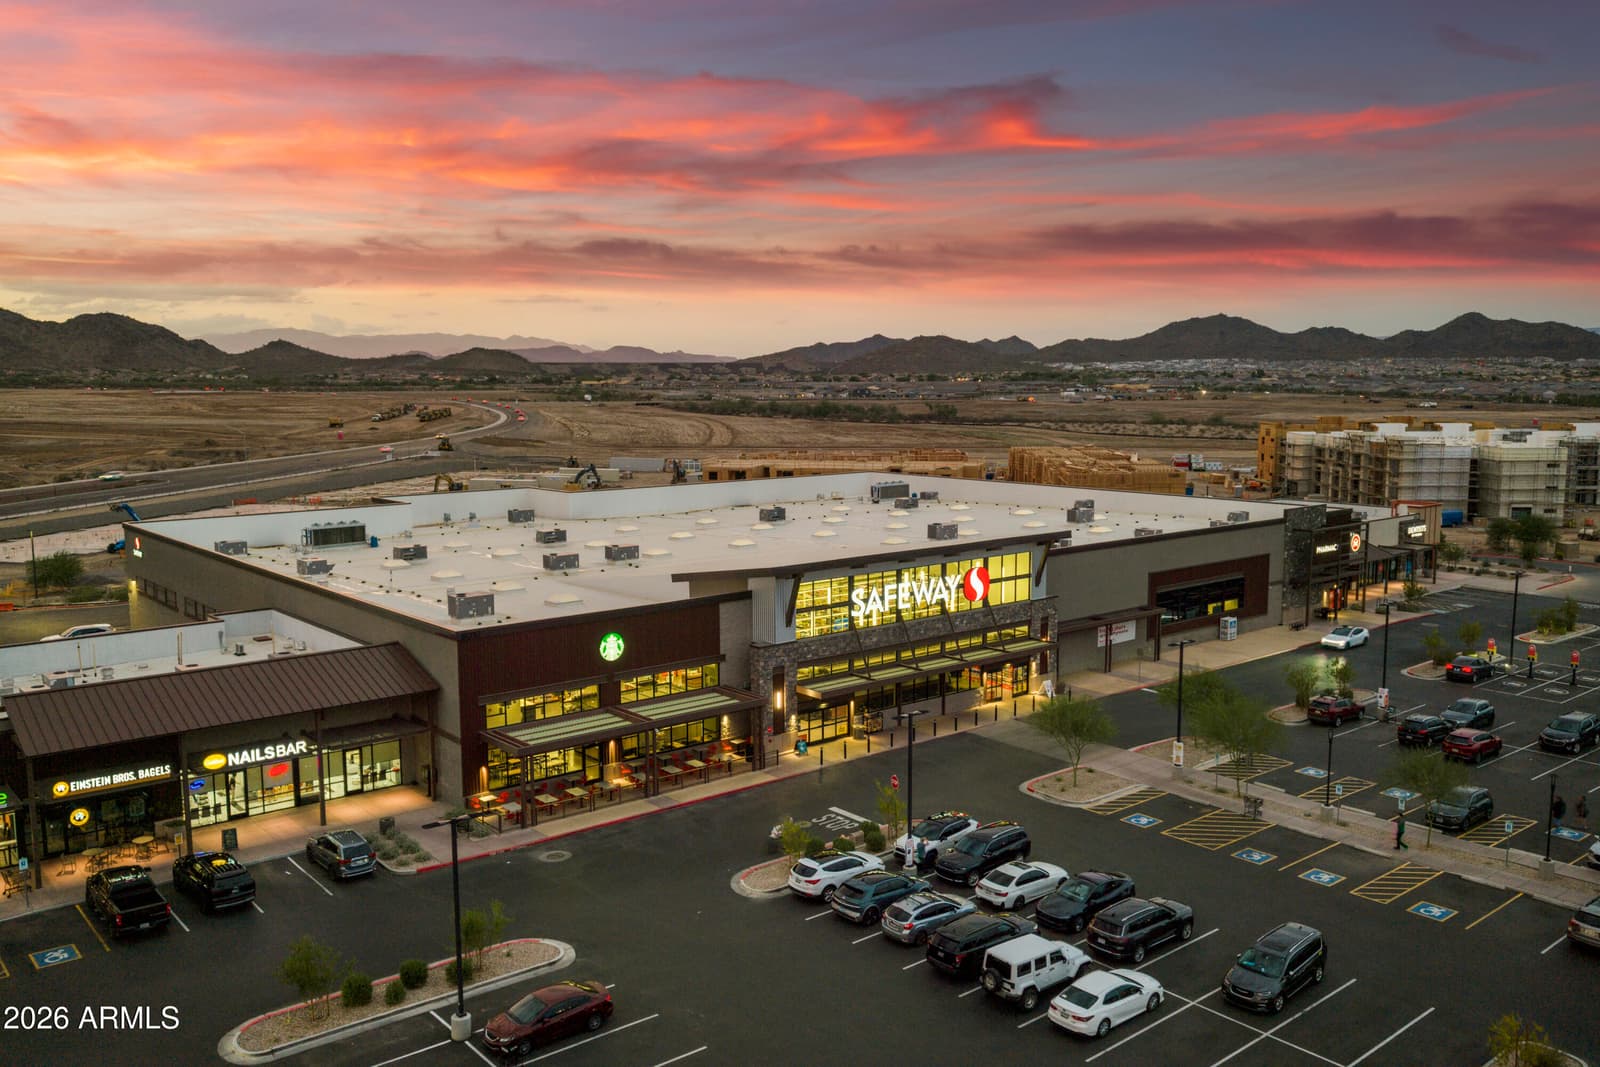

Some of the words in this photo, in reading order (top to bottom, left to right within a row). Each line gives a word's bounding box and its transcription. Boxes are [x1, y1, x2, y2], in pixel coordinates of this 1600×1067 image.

[1316, 543, 1338, 554] PHARMAC
[851, 574, 961, 616] SAFEWAY
[70, 775, 111, 791] EINSTEIN
[112, 771, 136, 784] BROS.
[138, 765, 171, 779] BAGELS
[811, 813, 859, 831] STOP
